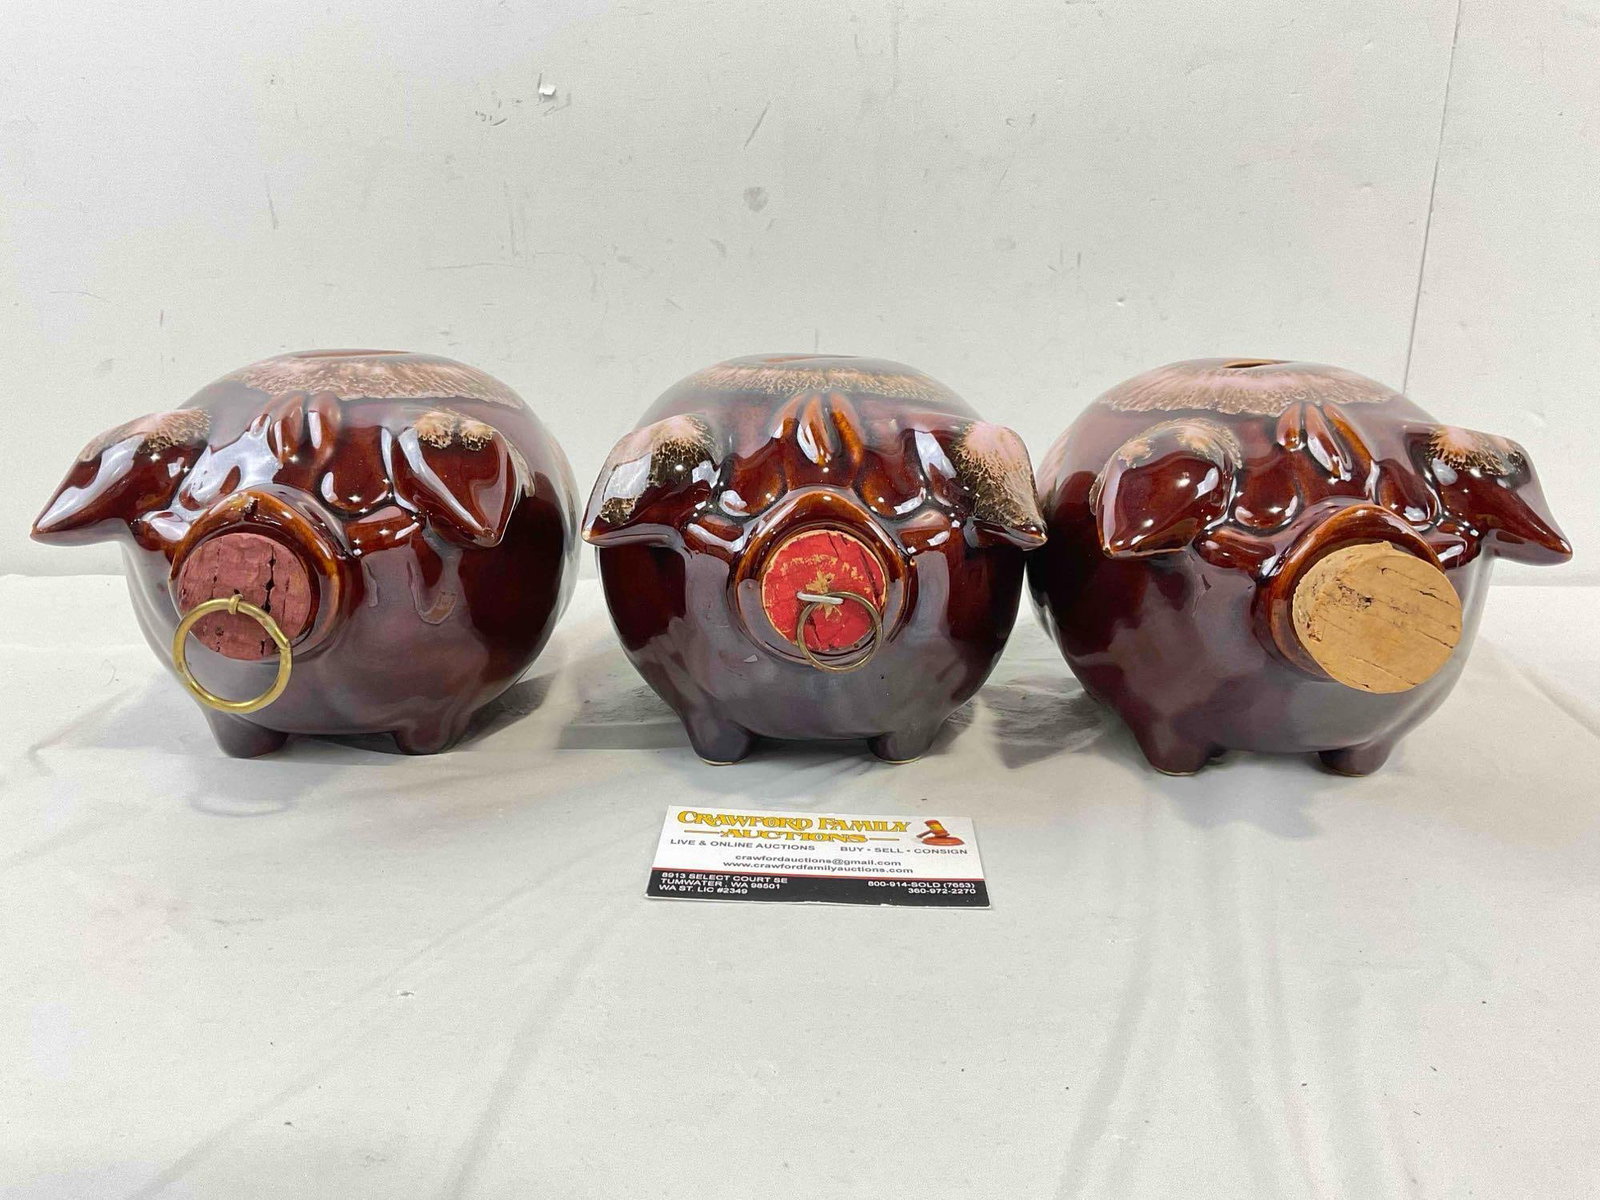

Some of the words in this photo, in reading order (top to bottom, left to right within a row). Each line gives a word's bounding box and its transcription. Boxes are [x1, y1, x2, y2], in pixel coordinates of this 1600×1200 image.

[677, 810, 813, 831] CRAWFORD
[818, 817, 912, 833] FAMILY
[721, 828, 868, 843] AUCTIONS
[670, 838, 695, 846] LIVE
[710, 840, 753, 848] ONLINE
[755, 843, 815, 851] AUCTIONS
[735, 854, 902, 866] crawfordauctions@gmail.com
[723, 861, 913, 874] www.crawfordfamilyauctions.com
[688, 873, 730, 881] SELECT
[732, 875, 771, 883] COURT
[867, 880, 941, 888] 800-914-SOLD
[717, 887, 748, 895] #2349
[750, 882, 781, 890] 98501
